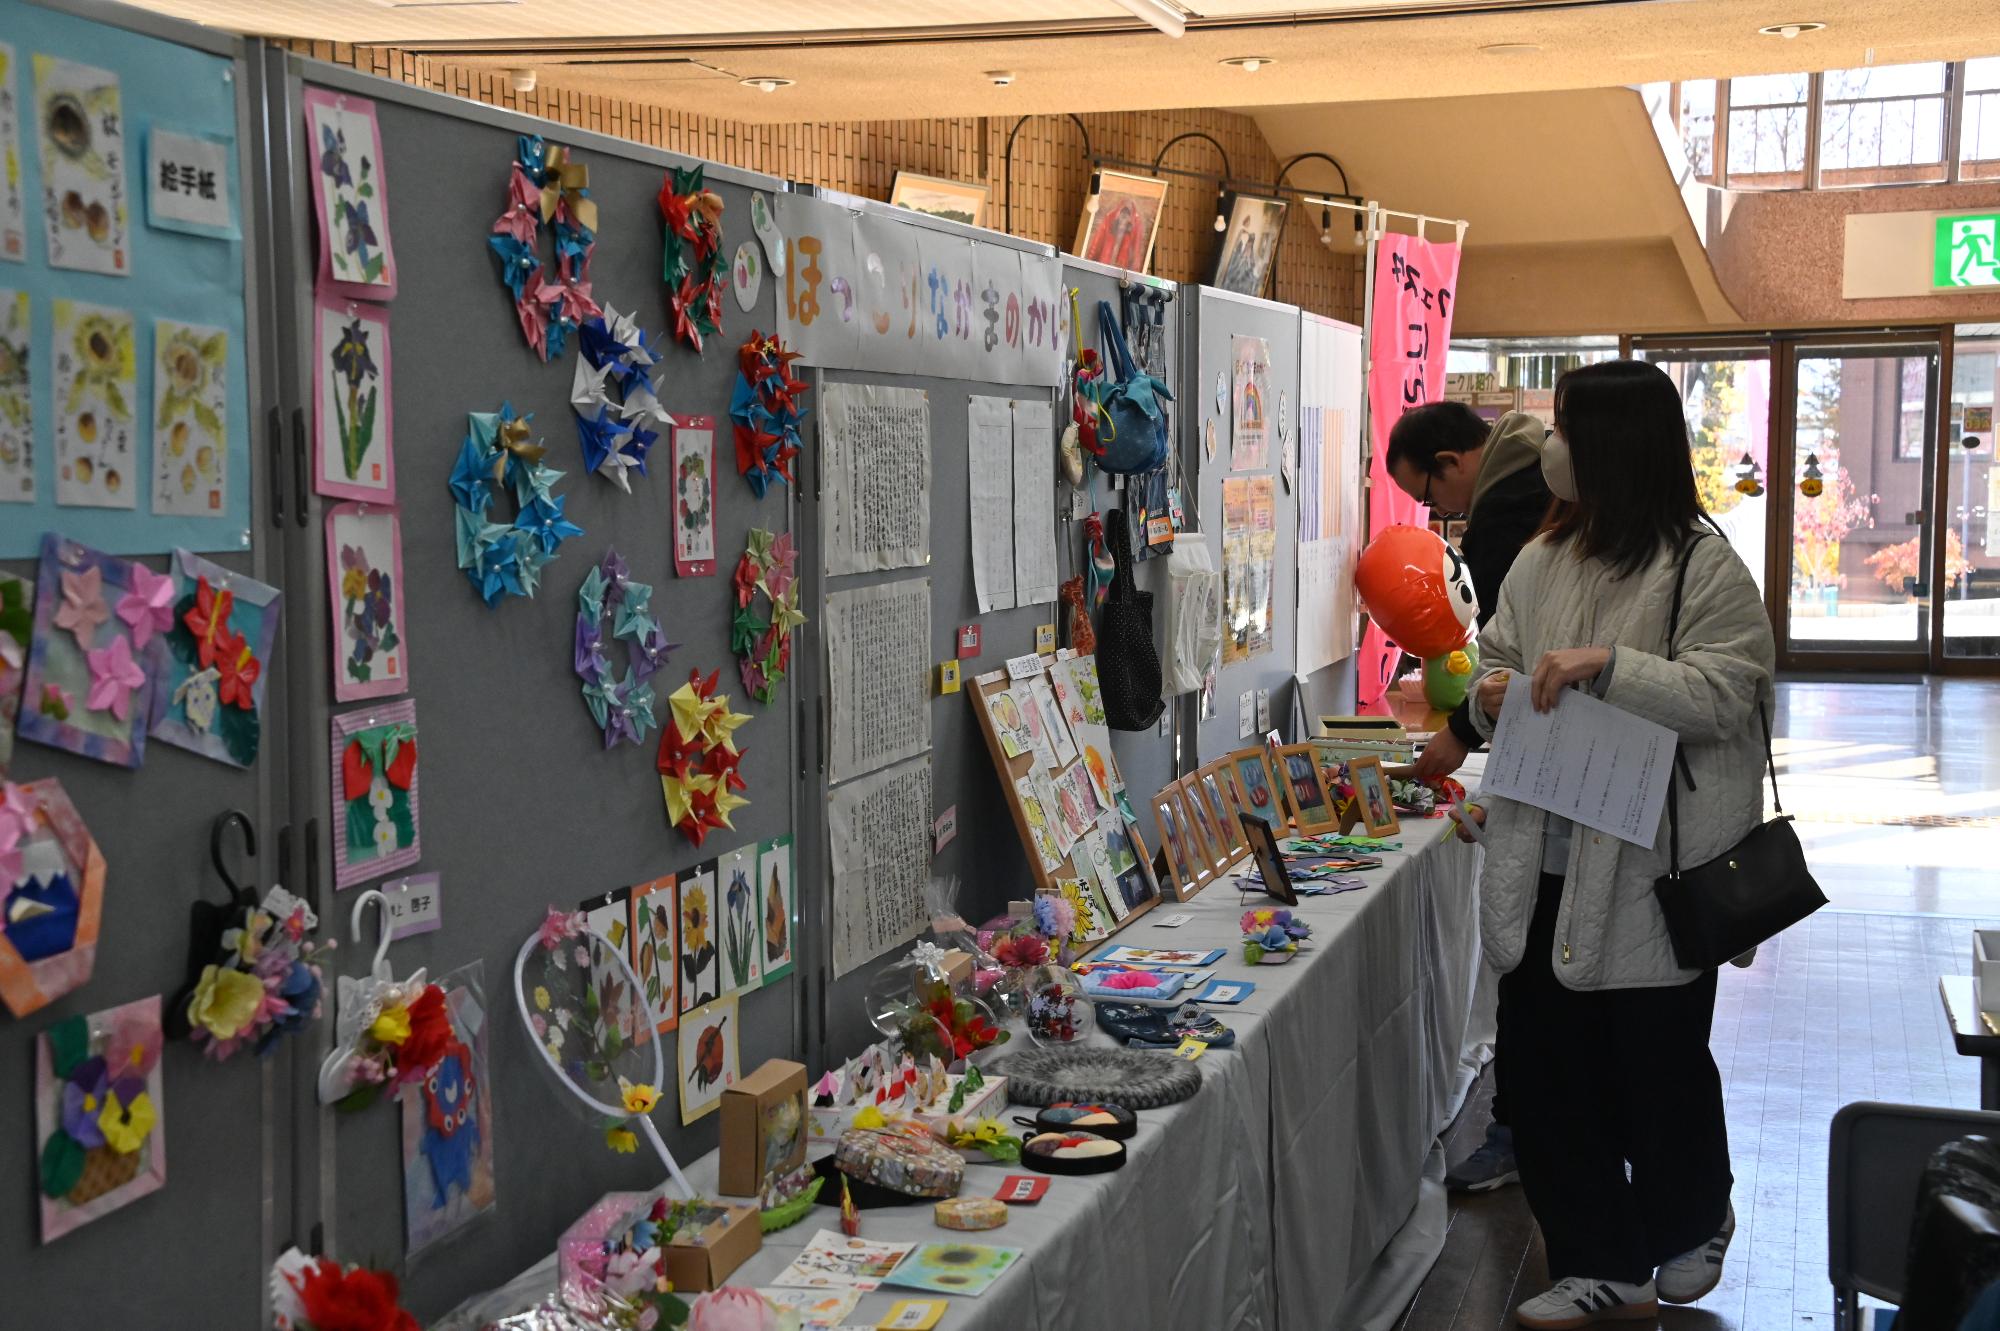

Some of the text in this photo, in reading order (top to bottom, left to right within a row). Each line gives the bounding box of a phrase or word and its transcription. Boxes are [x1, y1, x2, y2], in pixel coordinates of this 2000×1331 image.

[160, 158, 217, 201] 絵手紙
[1079, 878, 1099, 909] 元気
